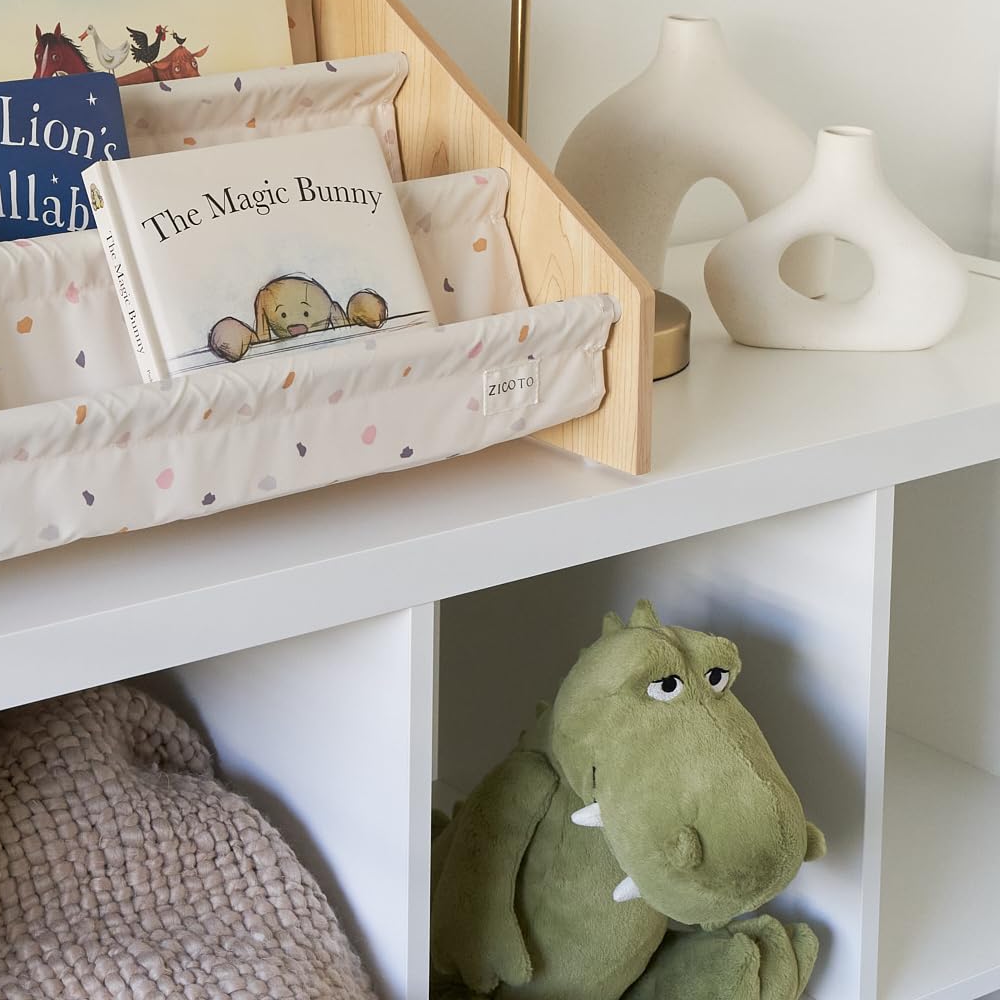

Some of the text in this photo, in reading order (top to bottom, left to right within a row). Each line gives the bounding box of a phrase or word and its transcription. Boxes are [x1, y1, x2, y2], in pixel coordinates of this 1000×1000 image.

[0, 94, 118, 162] Lion's
[140, 175, 384, 243] The Magic Bunny
[106, 231, 146, 355] The Magic Bunny
[487, 375, 535, 397] ZICOTO
